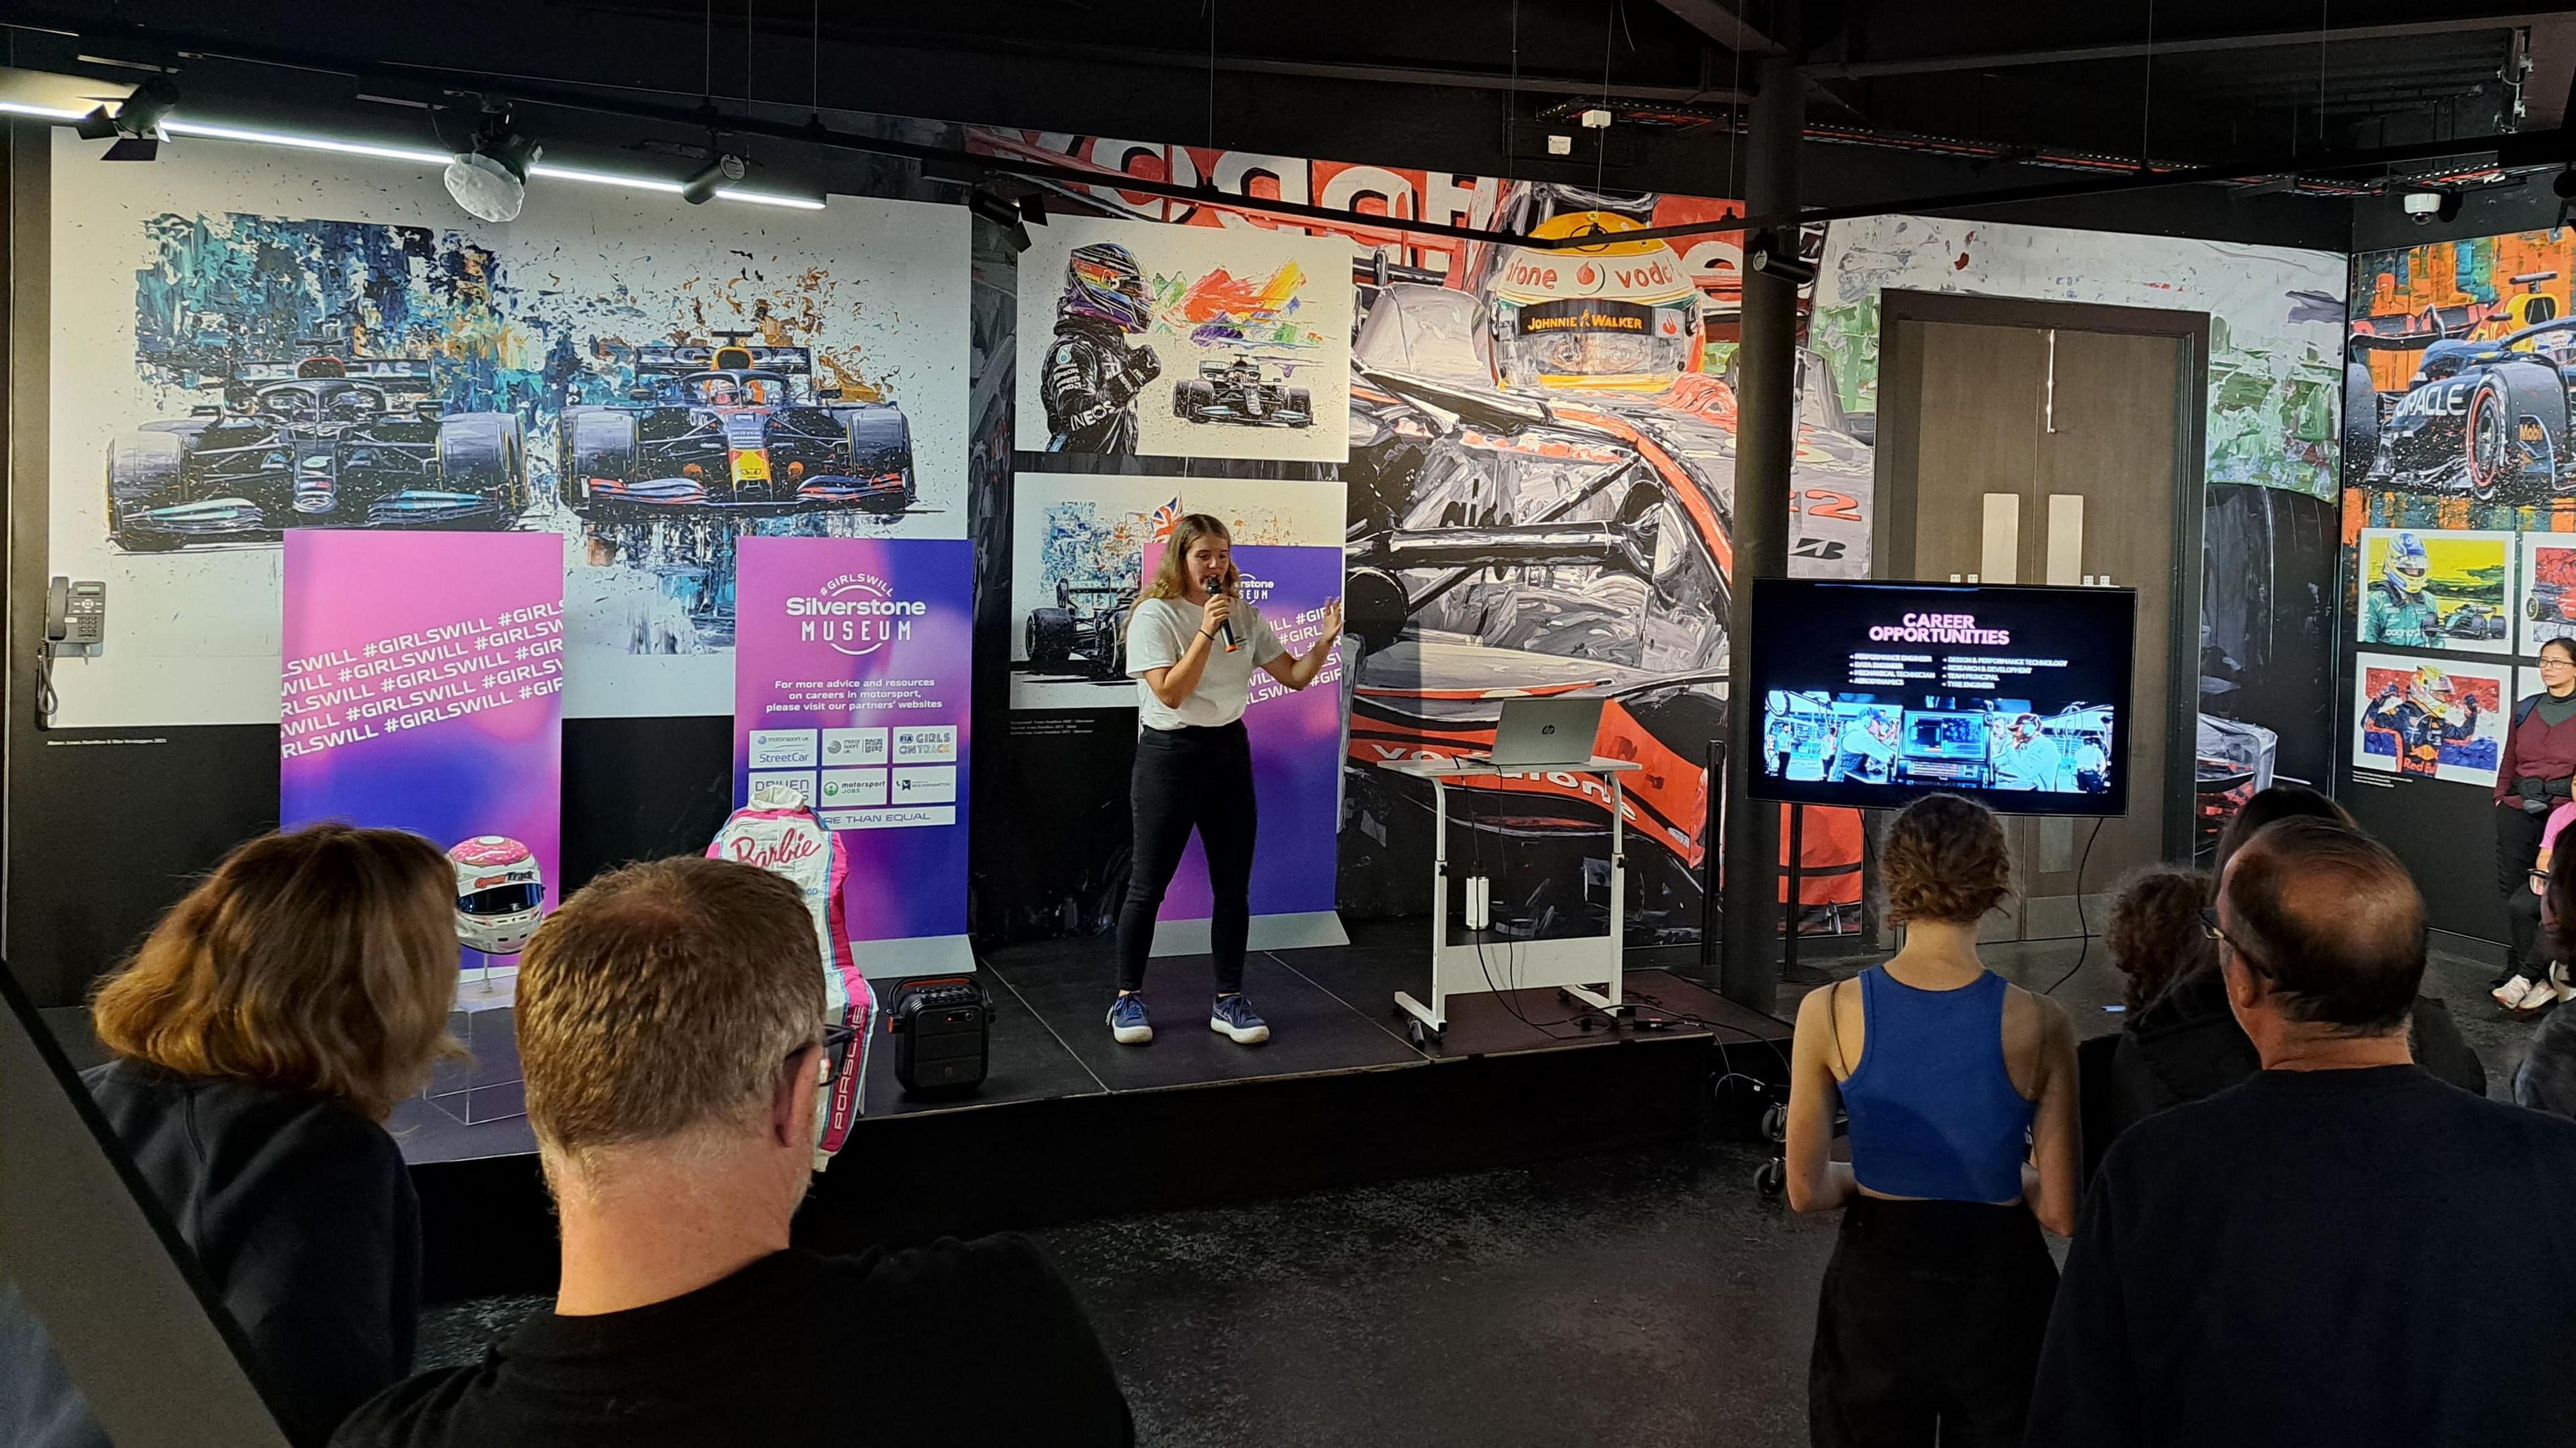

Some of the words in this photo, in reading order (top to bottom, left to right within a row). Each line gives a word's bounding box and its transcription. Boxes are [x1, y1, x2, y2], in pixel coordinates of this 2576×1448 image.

[1527, 317, 1577, 331] JOHNNIE
[1591, 315, 1642, 330] WALKER
[2395, 384, 2468, 416] ORACLE
[1071, 400, 1116, 431] INEOS
[820, 573, 894, 598] #GIRLSWILL
[1239, 590, 1268, 600] SEUM
[786, 597, 926, 616] Silverstone
[802, 620, 911, 641] MUSEUM
[1902, 613, 1976, 629] CAREER
[363, 618, 493, 659] #GIRLSWILL
[1869, 626, 2010, 645] OPPORTUNITIES
[337, 642, 469, 683] #GIRLSWILL
[381, 651, 511, 693] #GIRLSWILL
[775, 681, 793, 689] For
[796, 681, 824, 689] more
[826, 679, 860, 688] advice
[863, 679, 882, 687] and
[885, 679, 935, 687] resources
[345, 679, 477, 722] #GIRLSWILL
[788, 692, 802, 700] on
[806, 691, 845, 700] careers
[847, 691, 857, 699] in
[860, 689, 922, 700] motorsport,
[384, 691, 513, 733] #GIRLSWILL
[766, 704, 800, 714] please
[803, 702, 825, 711] visit
[828, 703, 847, 711] our
[898, 700, 943, 709] websites
[916, 732, 951, 744] GIRLS
[759, 753, 810, 763] StreetCar
[2404, 757, 2424, 772] Red
[841, 781, 885, 789] motorsport
[824, 816, 841, 825] RE
[846, 815, 881, 824] THAN
[885, 813, 931, 822] EQUAL
[834, 1007, 864, 1131] PORSCE
